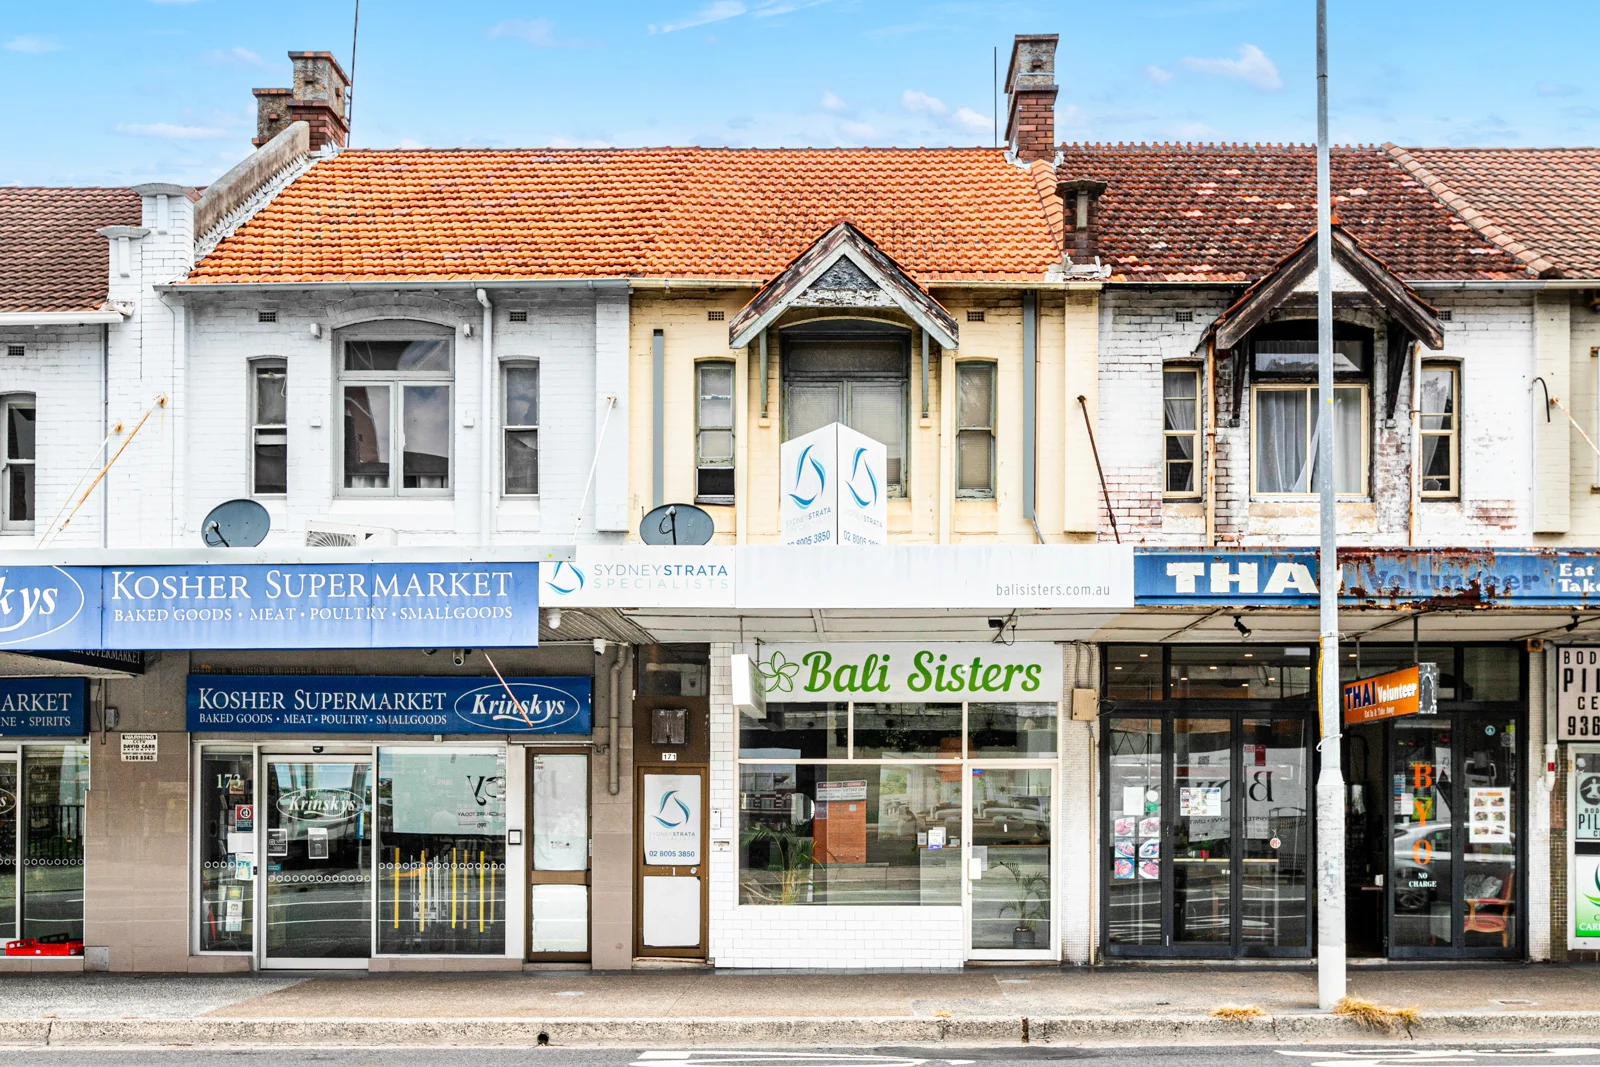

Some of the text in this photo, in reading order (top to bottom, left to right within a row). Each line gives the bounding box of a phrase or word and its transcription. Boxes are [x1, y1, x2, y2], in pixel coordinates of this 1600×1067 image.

[813, 530, 831, 544] 3850
[594, 564, 728, 576] SYDNEYSTRATA
[1559, 563, 1594, 577] Eat
[112, 570, 512, 600] KOSHER SUPERMARKET
[593, 578, 728, 589] SPECIALISTS
[1166, 562, 1343, 594] THA
[996, 584, 1110, 596] balisisters.com.au
[114, 606, 513, 622] BAKED GOODS MEAT POULTRY SMALLGOODS
[802, 650, 891, 693] Bali
[907, 650, 1041, 693] Sisters
[199, 688, 447, 711] KOSHER SUPERMARKET
[1345, 681, 1417, 711] THAI Volunteer
[470, 694, 566, 724] Krinskys
[29, 716, 71, 727] SPIRITS
[199, 713, 447, 725] BAKED GOODS MEAT POULTRY SMALLGOODS
[216, 774, 241, 789] 173
[288, 795, 356, 817] Krinskys
